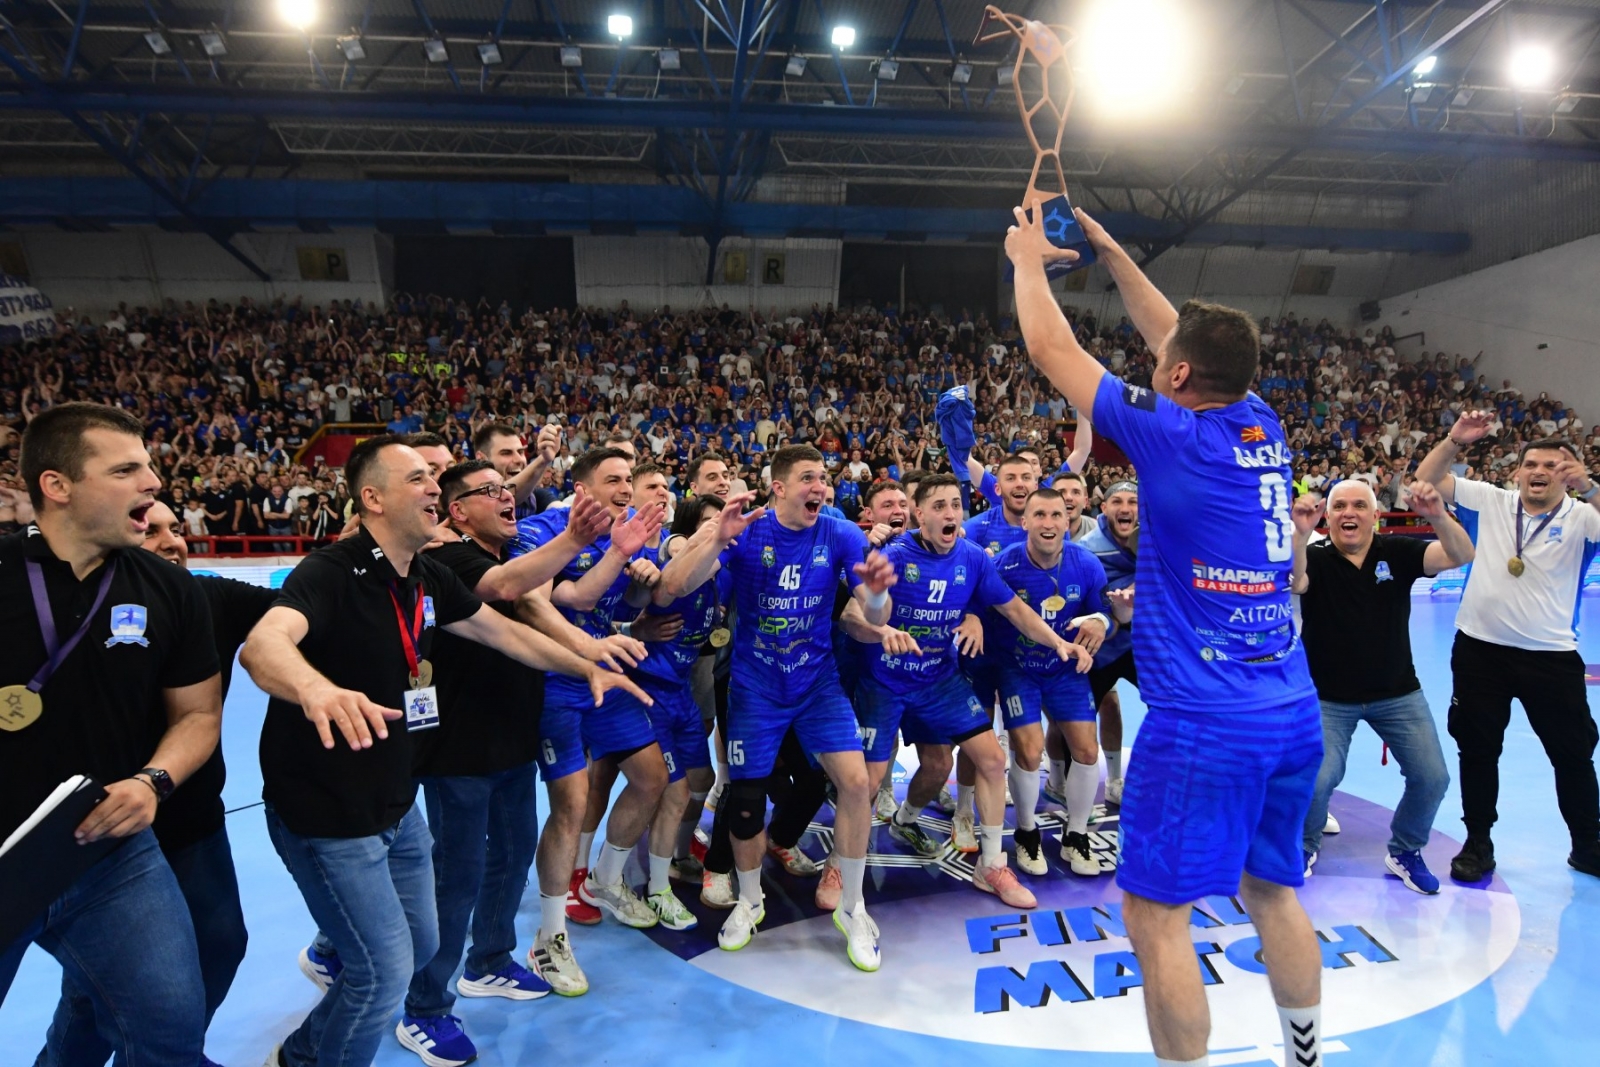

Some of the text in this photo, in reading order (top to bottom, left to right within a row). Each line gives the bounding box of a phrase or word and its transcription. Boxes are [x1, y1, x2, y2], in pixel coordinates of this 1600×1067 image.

[327, 252, 341, 276] P
[766, 258, 780, 280] R
[778, 564, 801, 590] 45
[927, 579, 947, 604] 27
[1006, 694, 1024, 718] 19
